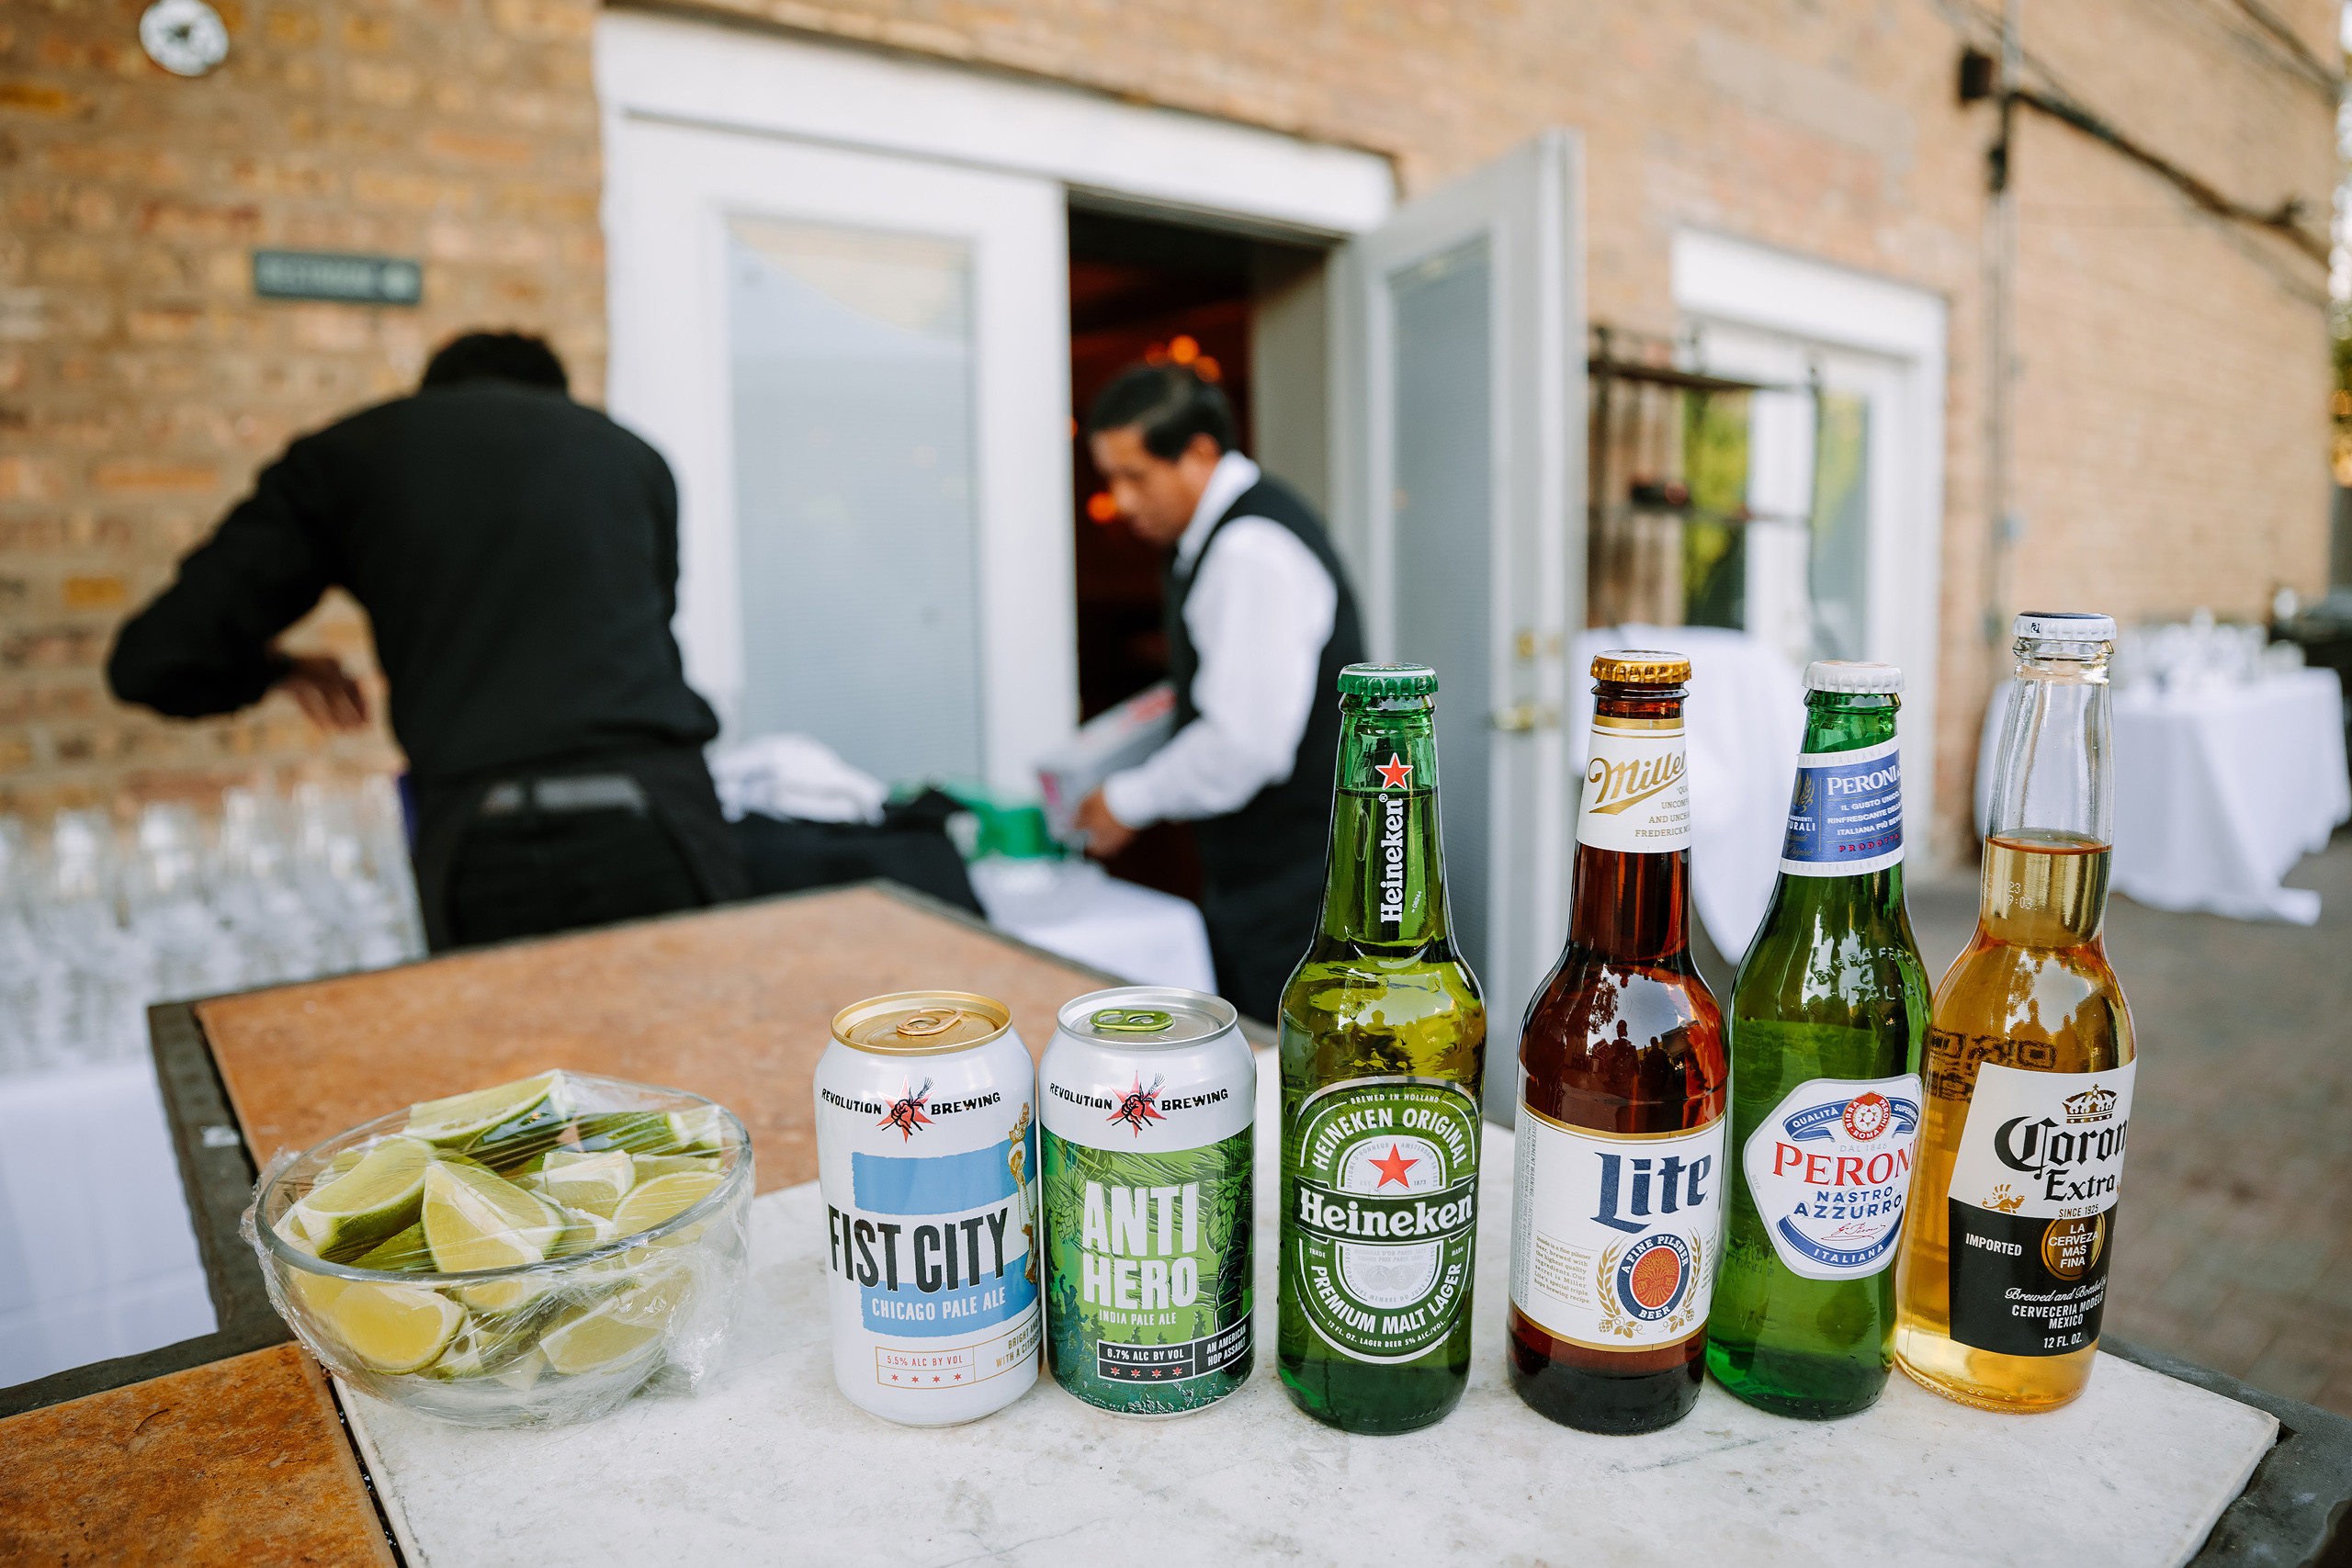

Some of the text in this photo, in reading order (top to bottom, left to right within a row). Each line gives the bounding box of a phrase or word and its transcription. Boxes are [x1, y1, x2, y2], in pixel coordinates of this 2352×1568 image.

[1851, 799, 1881, 810] GUSTO
[1648, 816, 1668, 824] AND
[1827, 808, 1887, 824] RINFRESCANTE
[1838, 825, 1875, 836] ITALIANA
[1838, 833, 1899, 852] PRODOTTA
[821, 1088, 1001, 1115] REVOLUTION BREWING
[1049, 1082, 1228, 1111] REVOLUTION BREWING
[1351, 1094, 1385, 1105] BREWED
[1404, 1093, 1440, 1103] HOLLAND
[1792, 1107, 1838, 1128] QUALITÀ
[1845, 1099, 1889, 1129] BIRRA PERONI
[1311, 1108, 1467, 1171] HEINEKEN ORIGINAL
[1853, 1128, 1880, 1139] ROMA
[1839, 1145, 1860, 1153] DAL
[1994, 1115, 2128, 1179] Coron
[1589, 1151, 1712, 1235] Lite
[2043, 1168, 2116, 1202] Extra
[1816, 1186, 1894, 1203] NASTRO
[1793, 1194, 1902, 1220] AZZURRO
[2058, 1203, 2099, 1218] SINCE 1925
[1082, 1180, 1199, 1257] ANTI
[2069, 1223, 2085, 1234] LA
[828, 1202, 1008, 1293] FIST CITY
[1965, 1233, 2022, 1257] IMPORTED
[2049, 1232, 2099, 1247] CERVEZA
[1309, 1247, 1326, 1258] TRADE
[1625, 1238, 1654, 1263] FINE
[1657, 1235, 1689, 1267] PILSNER
[1813, 1244, 1884, 1263] ITALIANA
[2062, 1245, 2087, 1258] MAS
[1564, 1264, 1588, 1274] quality
[1572, 1258, 1589, 1267] with
[1621, 1265, 1632, 1274] A
[2060, 1256, 2086, 1269] FINA
[1082, 1253, 1199, 1310] HERO
[1563, 1277, 1587, 1289] Miller
[1572, 1272, 1587, 1281] Our
[1310, 1262, 1462, 1335] PREMIUM MALT LAGER
[1570, 1287, 1589, 1296] triple
[2004, 1287, 2057, 1303] Brewed
[2053, 1287, 2077, 1302] and
[872, 1286, 1006, 1321] CHICAGO PALE ALE
[1638, 1305, 1671, 1319] BEER
[2011, 1290, 2104, 1318] CERVECERIA MODELO
[1099, 1309, 1177, 1326] INDIA PALE ALE
[2048, 1314, 2084, 1330] MEXICO
[1008, 1327, 1029, 1349] BRIGHT
[1206, 1323, 1247, 1355] AN AMERICAN
[1327, 1320, 1335, 1329] 12
[1334, 1325, 1344, 1337] FL.
[1345, 1332, 1357, 1343] OZ.
[1359, 1337, 1382, 1348] LAGER
[1417, 1320, 1446, 1342] ALC./VOL.
[2043, 1332, 2083, 1349] 12 FL. OZ.
[996, 1351, 1014, 1368] WITH
[1015, 1348, 1020, 1359] A
[1132, 1349, 1149, 1361] ALC
[1153, 1349, 1165, 1361] BY
[1167, 1348, 1184, 1359] VOL
[1207, 1337, 1247, 1367] HOP ASSAULT
[887, 1355, 964, 1367] 5.5% ALC BY VOL
